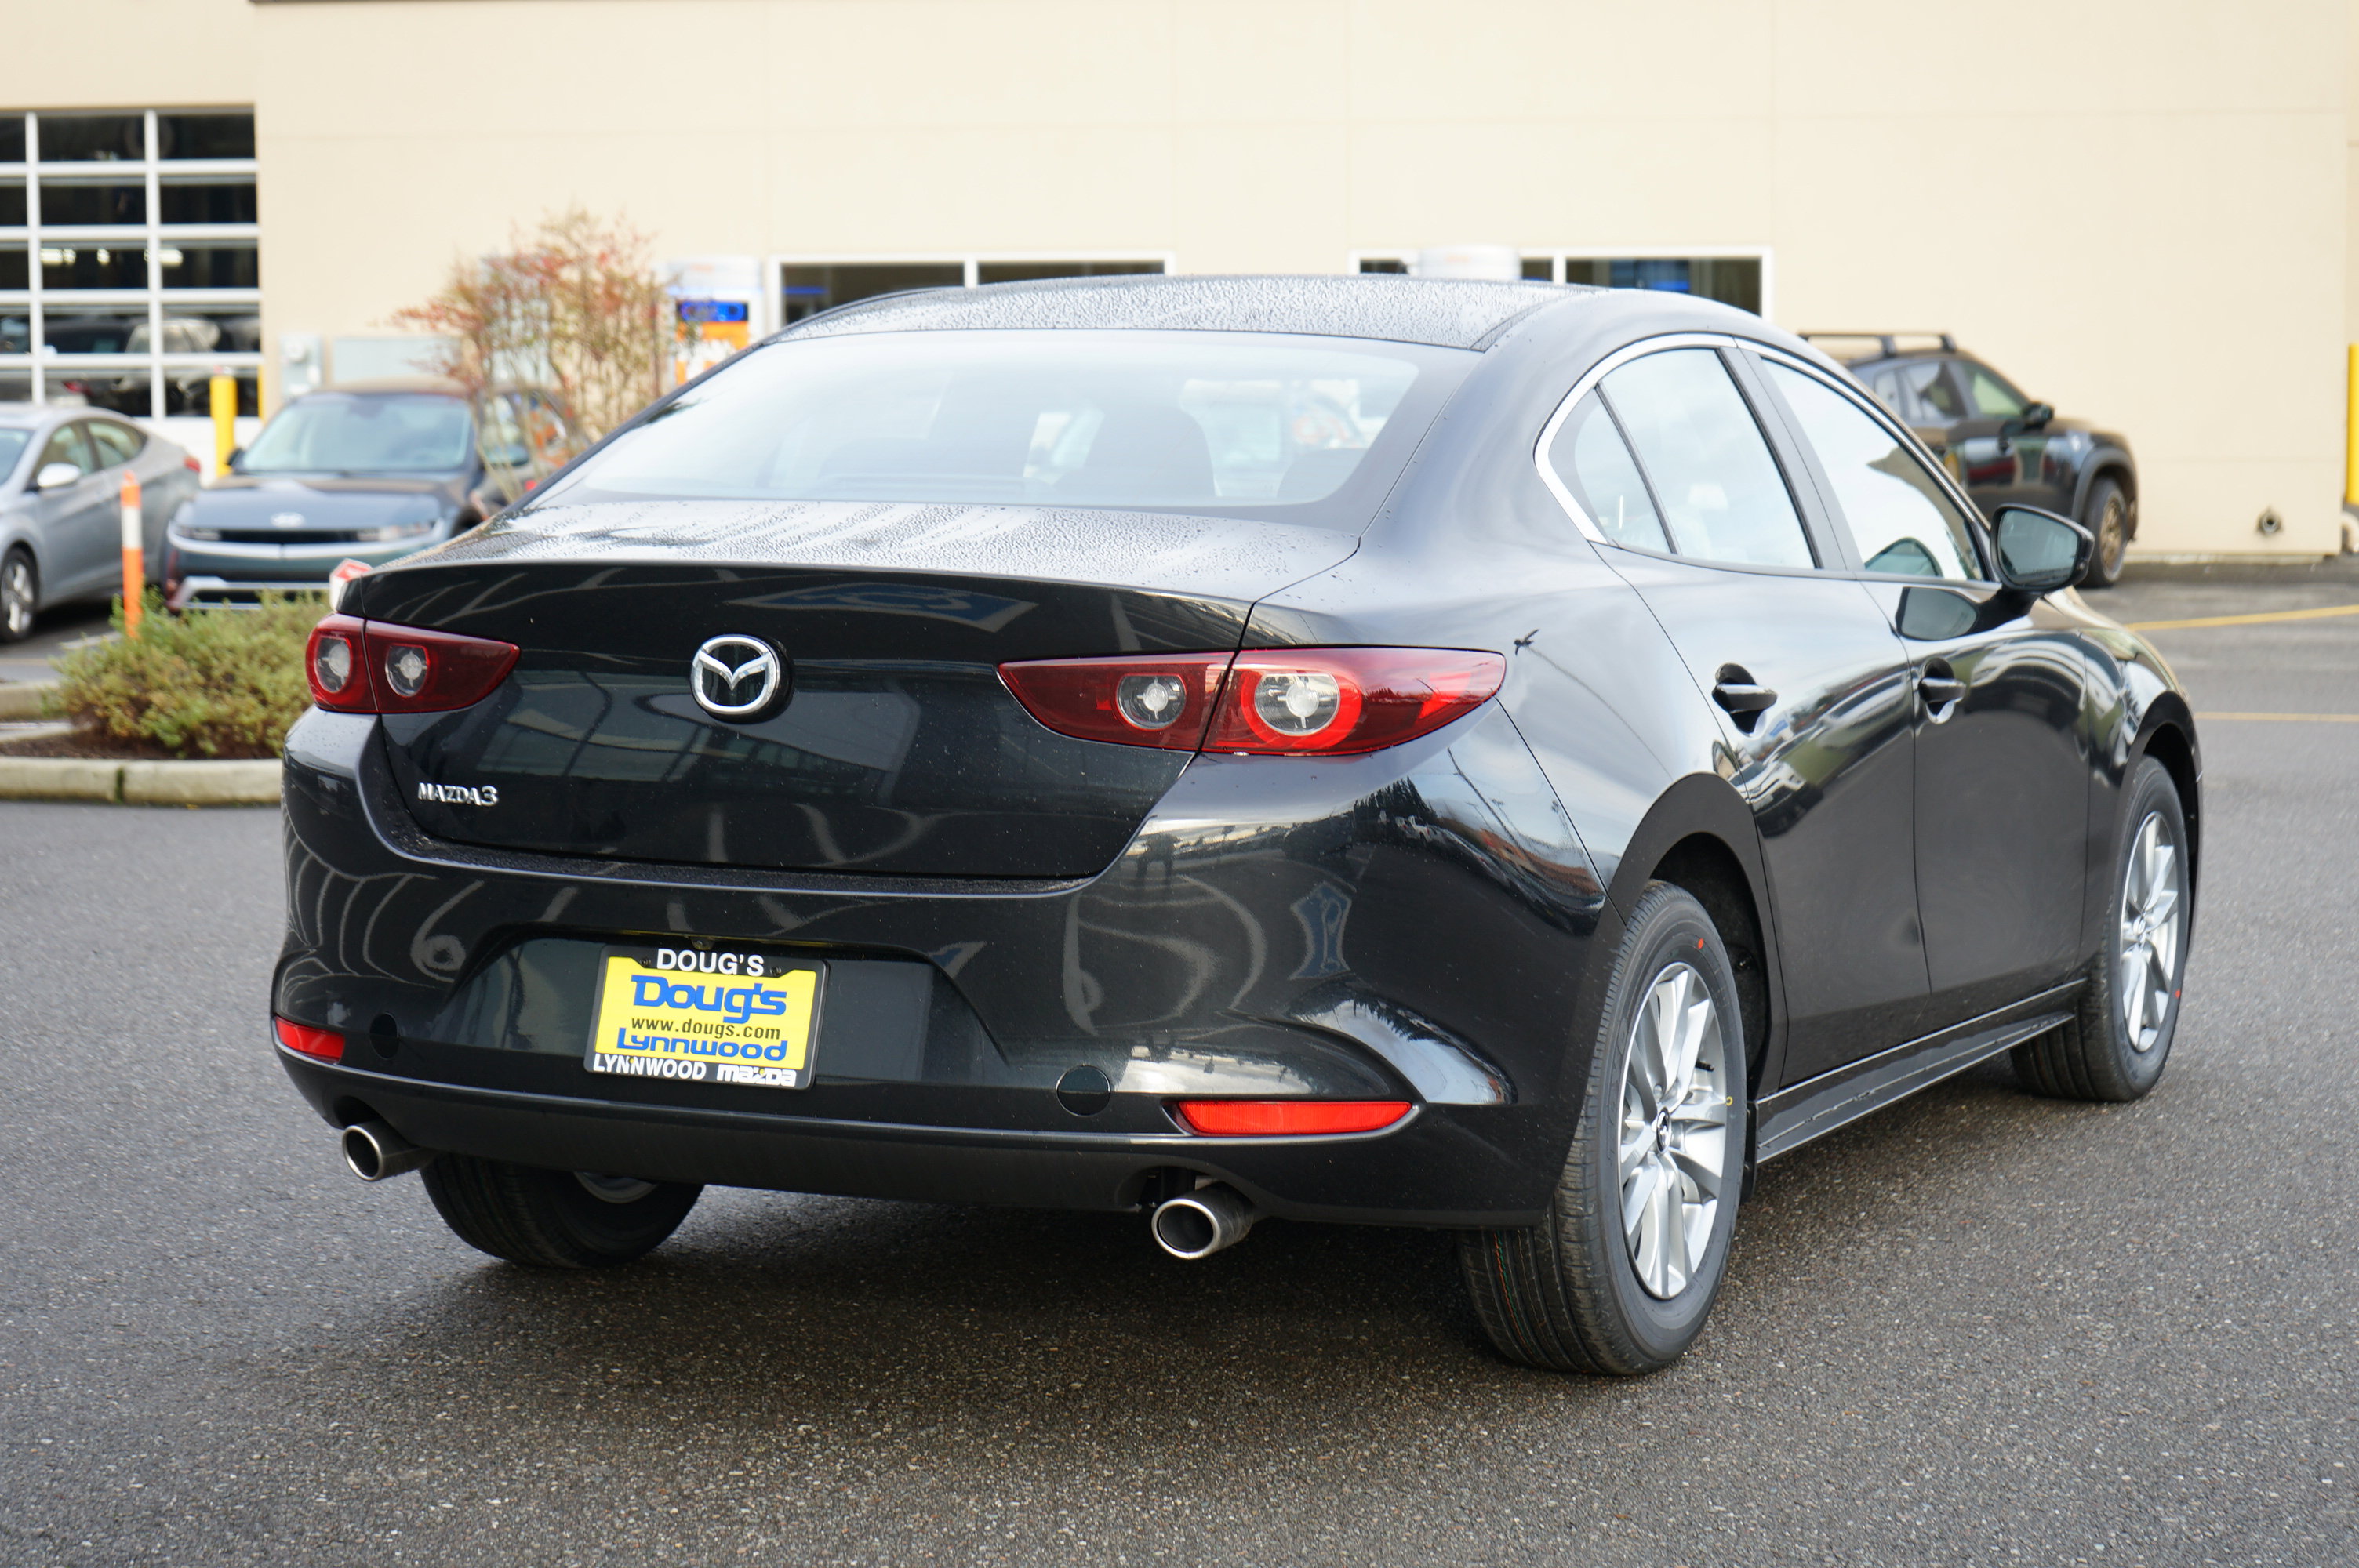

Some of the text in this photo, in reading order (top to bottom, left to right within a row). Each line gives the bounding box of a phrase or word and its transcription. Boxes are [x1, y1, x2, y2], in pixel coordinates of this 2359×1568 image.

[417, 782, 500, 806] MAZDA3
[656, 948, 765, 976] DOUG'S
[631, 975, 787, 1024] Doug's
[631, 1018, 780, 1040] www.dougs.com
[617, 1028, 787, 1061] Lynnwood
[594, 1053, 707, 1080] LYNNWOOD
